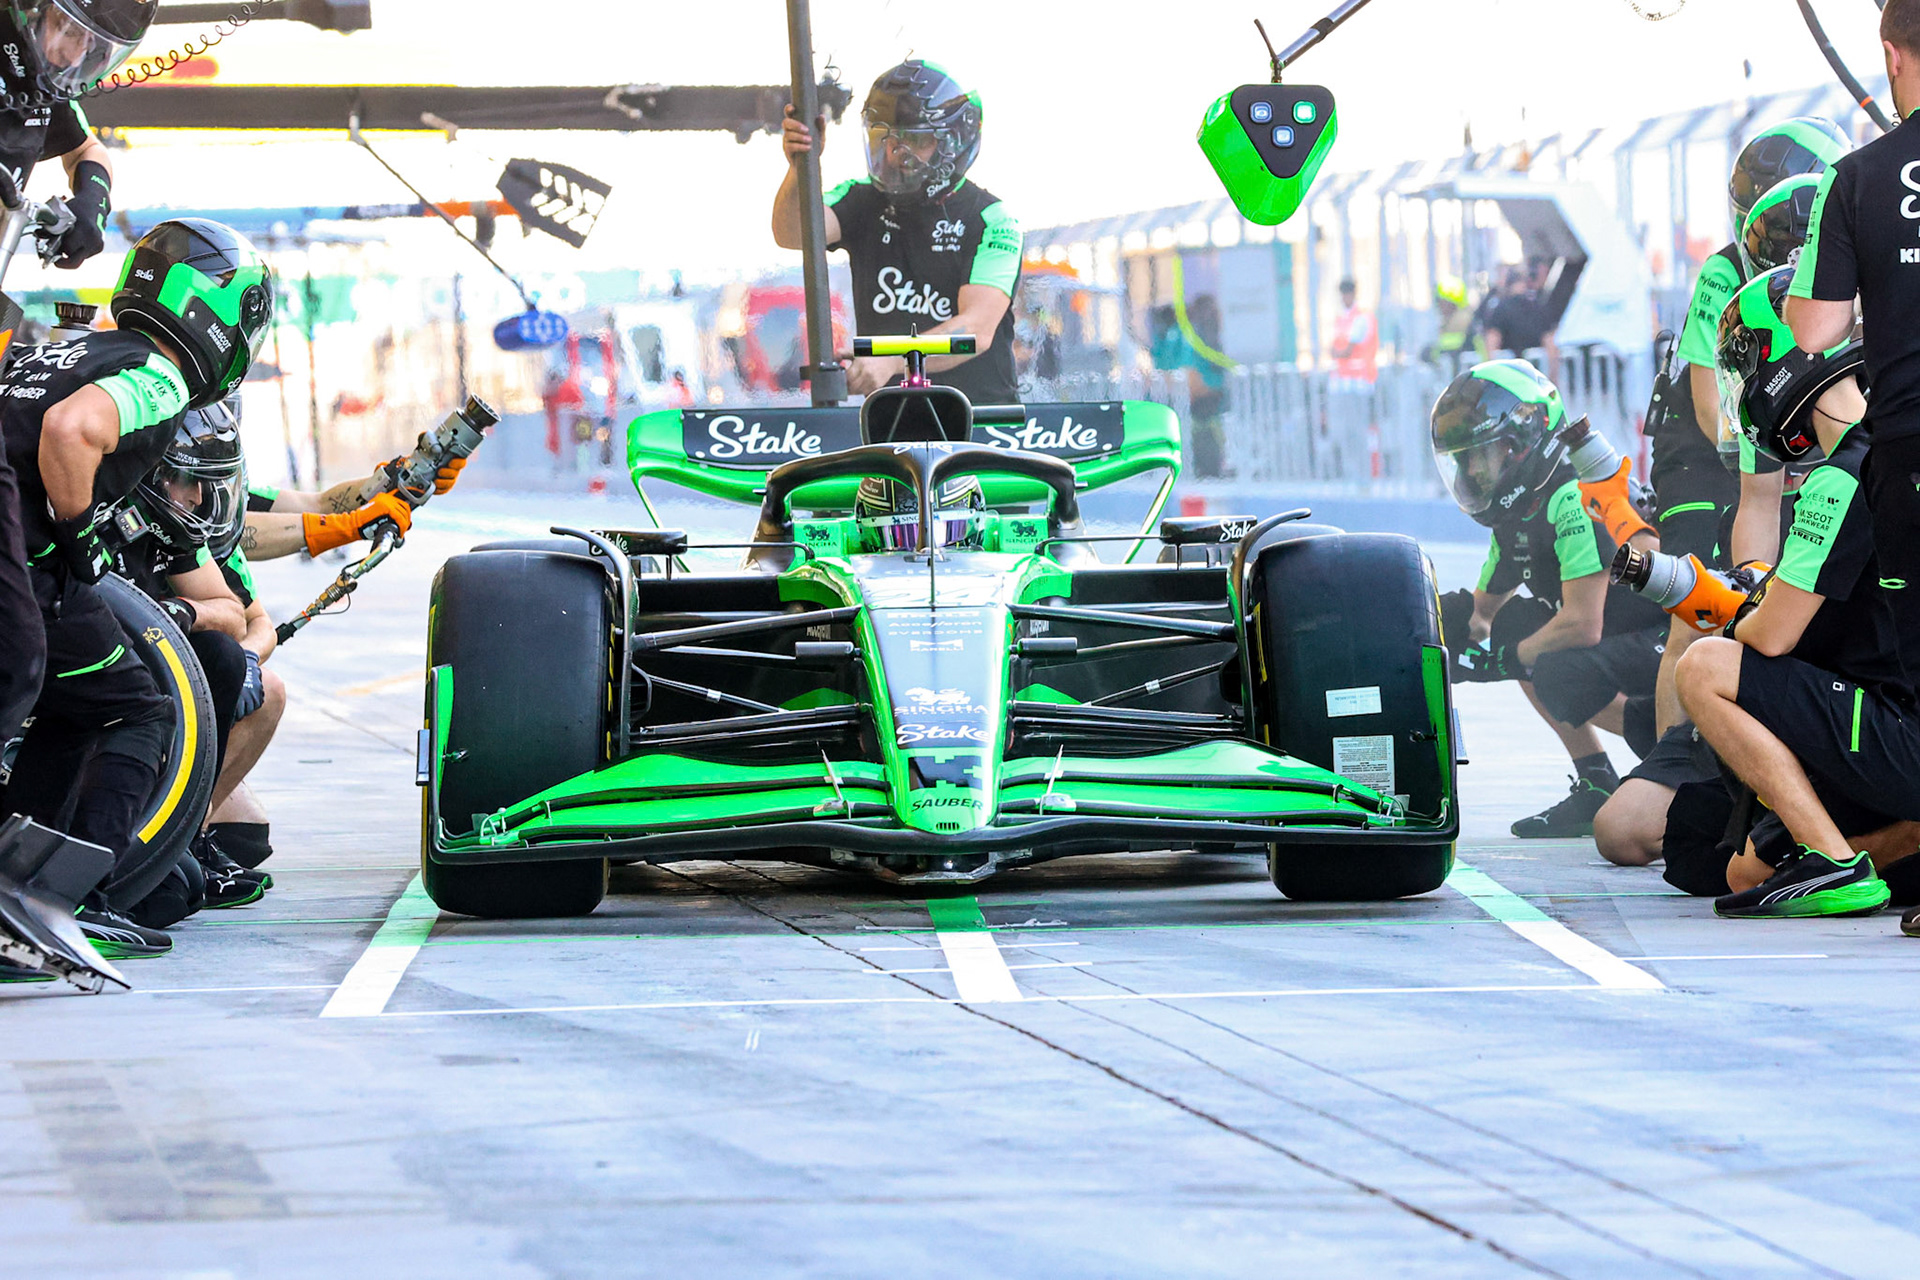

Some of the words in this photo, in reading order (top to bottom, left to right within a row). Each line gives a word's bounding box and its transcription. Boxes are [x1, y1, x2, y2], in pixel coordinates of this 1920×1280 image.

[872, 265, 953, 322] Stake
[210, 322, 233, 350] MASCOT
[1764, 366, 1789, 395] MASCOT
[1769, 373, 1793, 398] WORKWEAR
[708, 415, 822, 458] Stake
[894, 704, 989, 714] SINGHA
[896, 723, 991, 745] Stake
[911, 798, 984, 812] SAUBER
